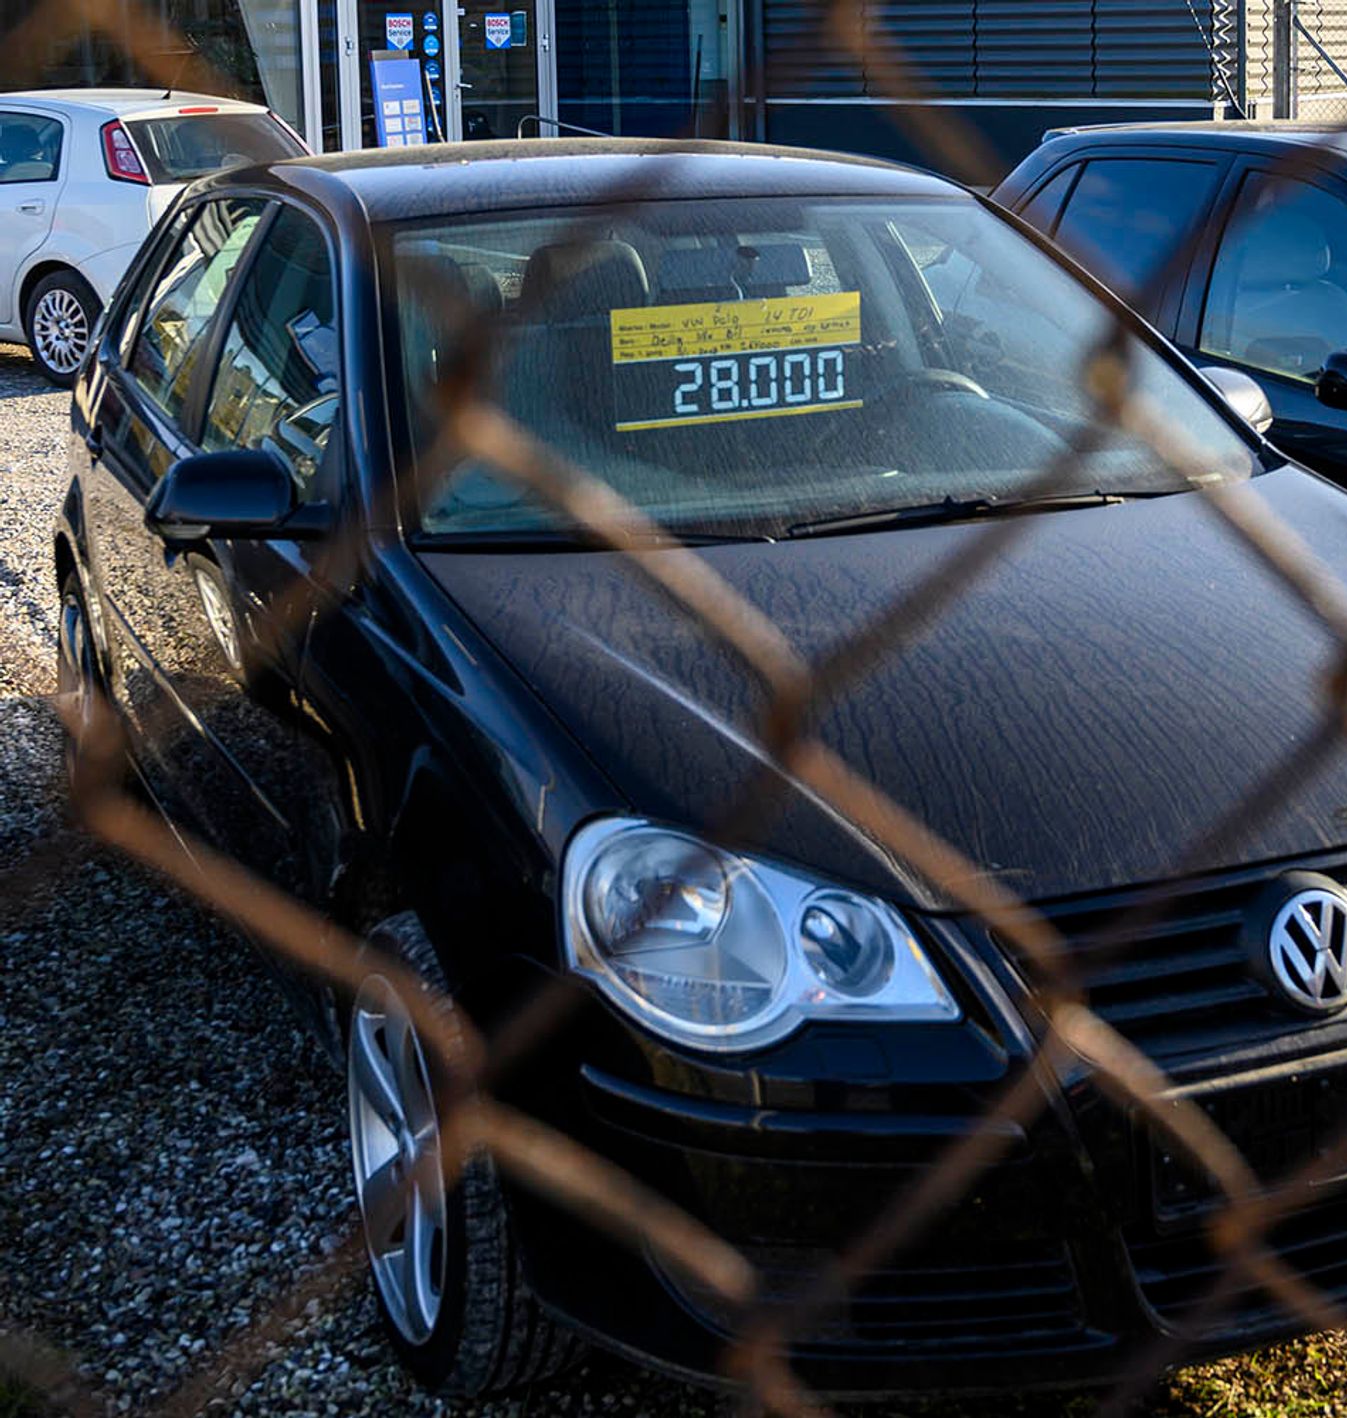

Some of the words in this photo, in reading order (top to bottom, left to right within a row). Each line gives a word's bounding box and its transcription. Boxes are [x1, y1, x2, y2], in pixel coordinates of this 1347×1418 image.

[388, 17, 411, 27] BOSCH
[487, 17, 508, 27] BOSCH
[388, 28, 411, 37] Service
[487, 28, 508, 36] Service
[674, 350, 844, 413] 28.000
